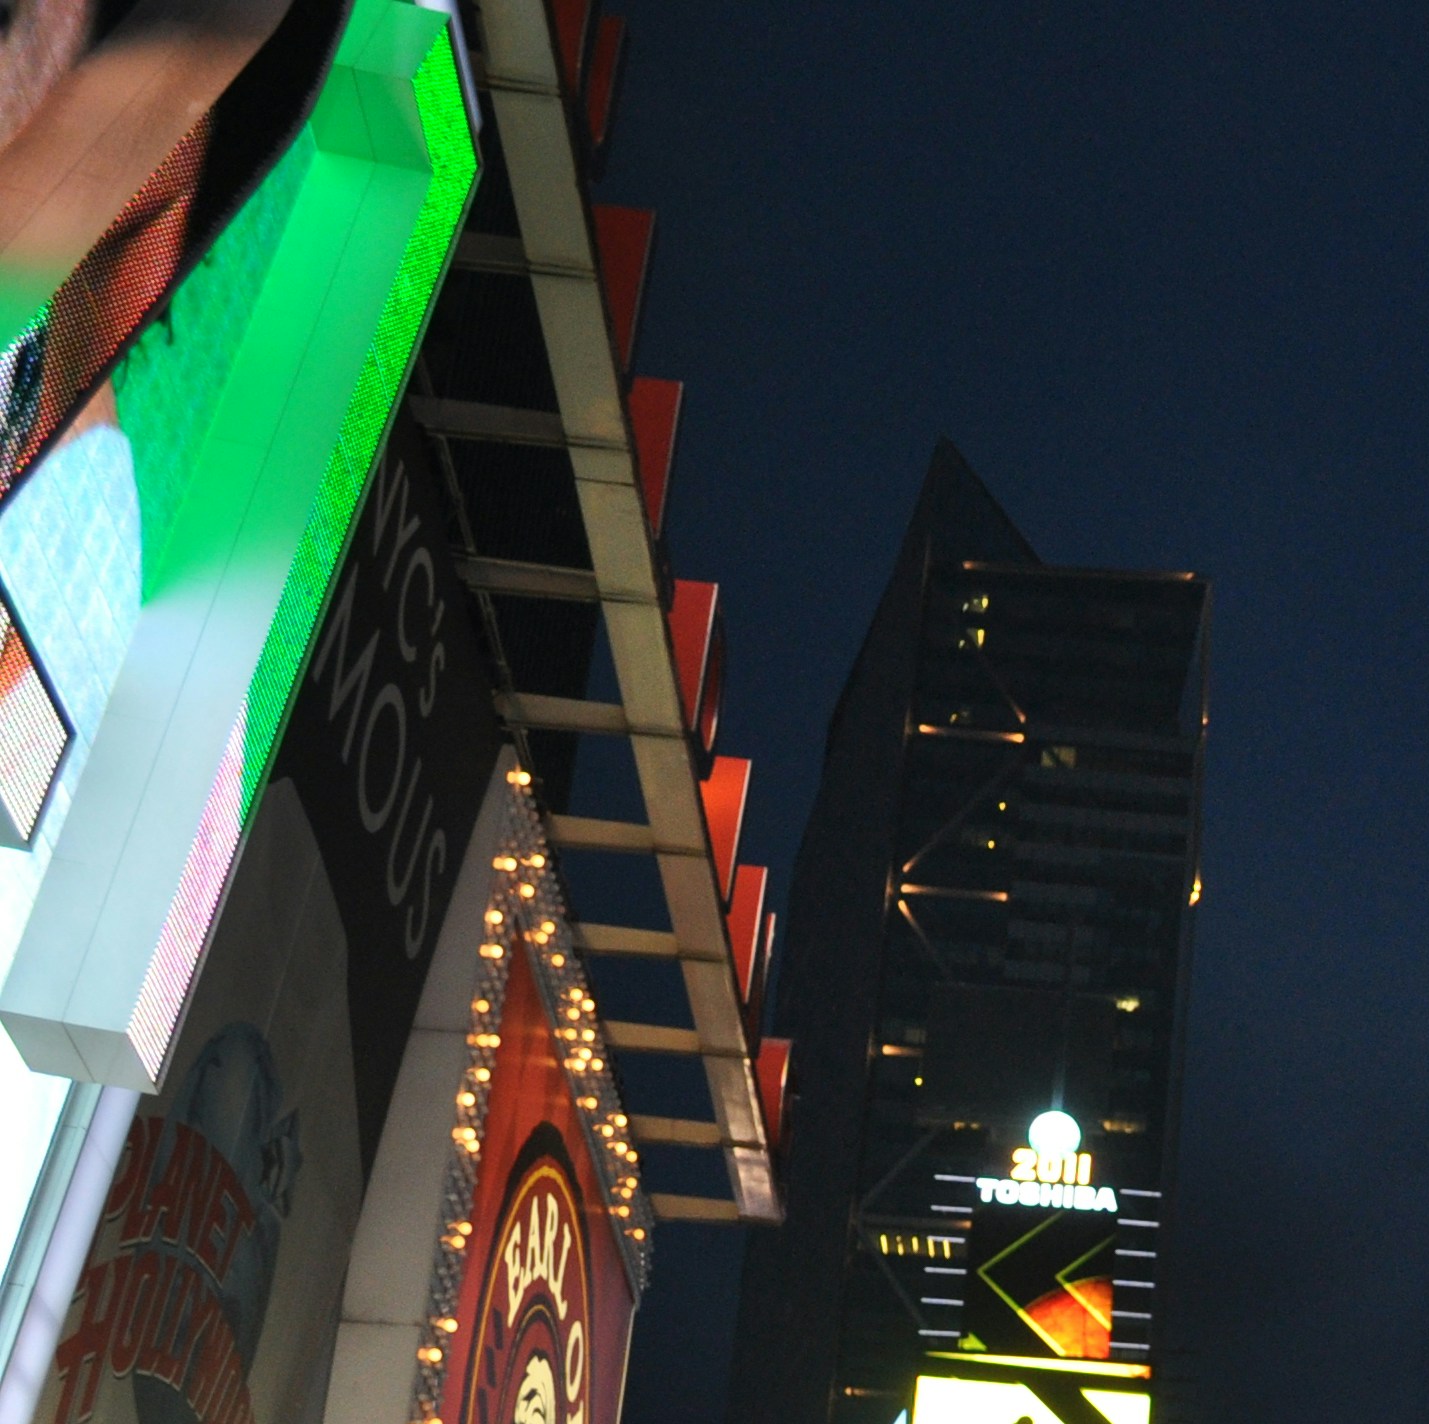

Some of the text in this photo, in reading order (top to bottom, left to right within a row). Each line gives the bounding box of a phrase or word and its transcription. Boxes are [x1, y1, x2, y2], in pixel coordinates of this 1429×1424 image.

[1011, 1147, 1092, 1186] 2011
[975, 1177, 1119, 1213] TOSHIBA
[504, 1193, 572, 1328] EARL
